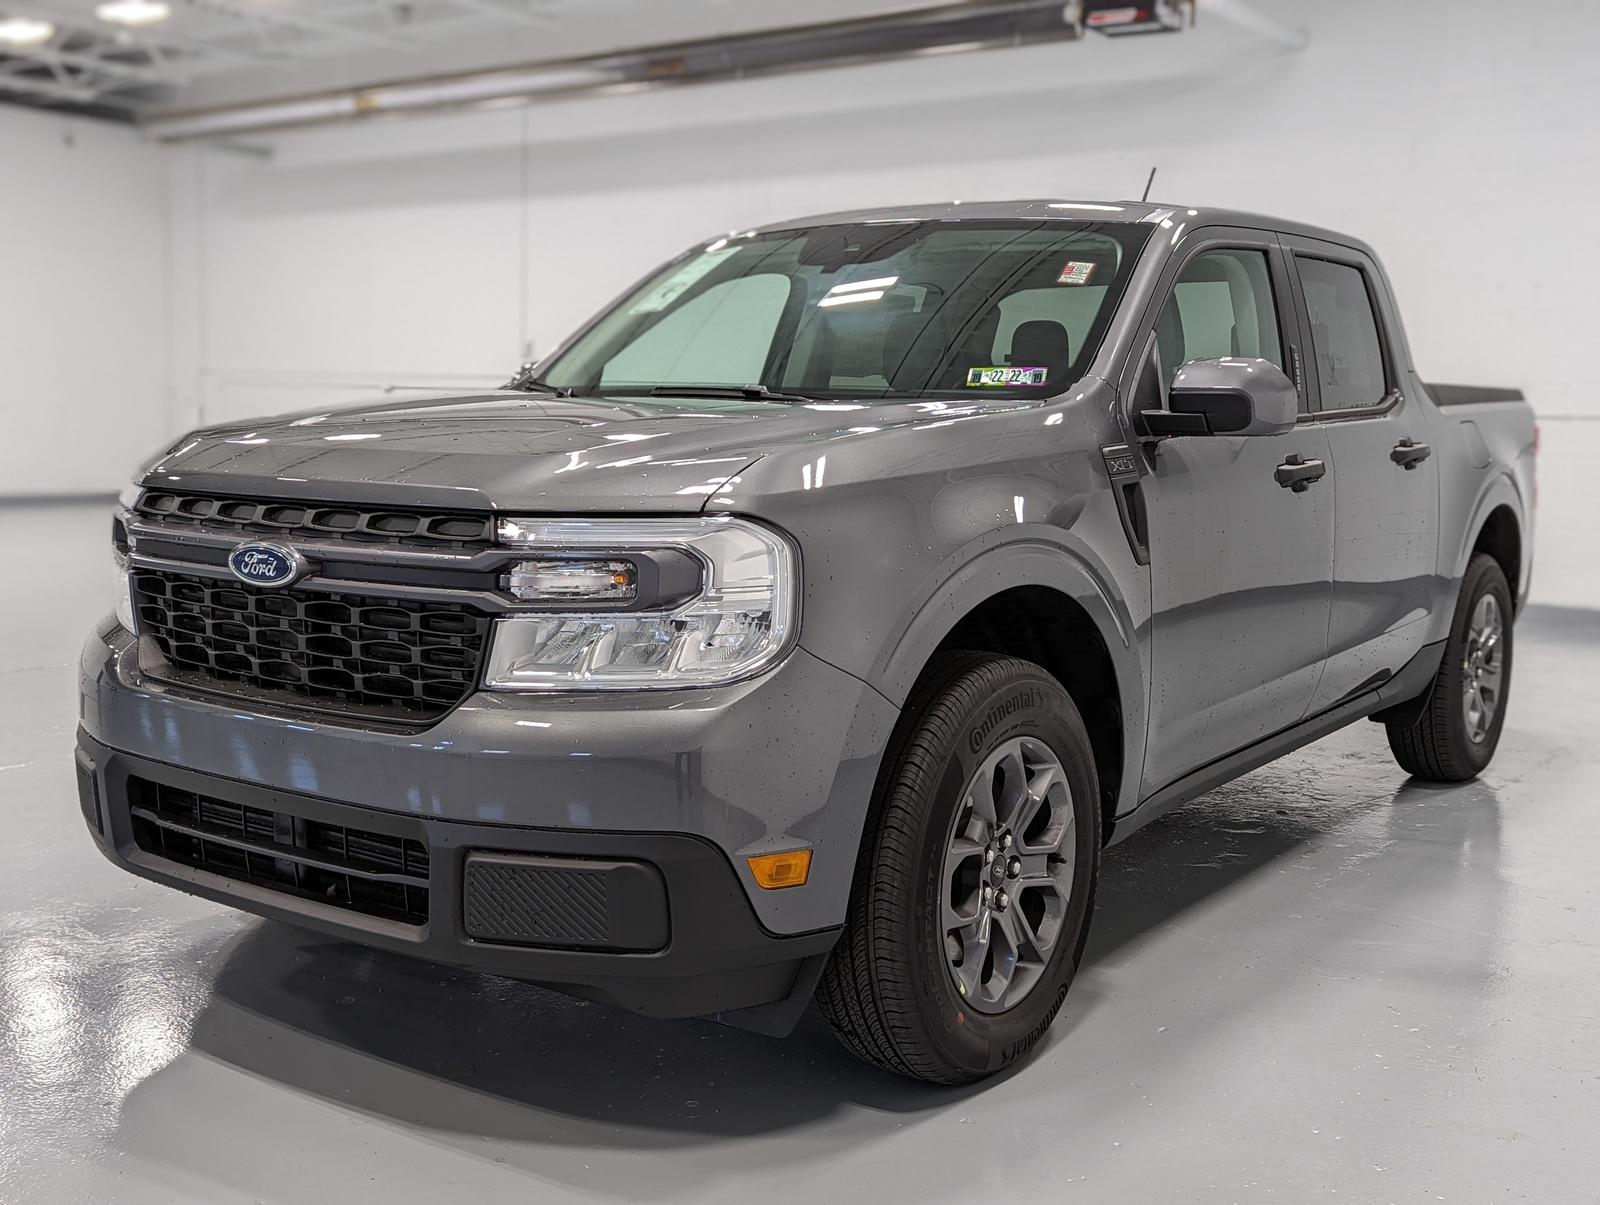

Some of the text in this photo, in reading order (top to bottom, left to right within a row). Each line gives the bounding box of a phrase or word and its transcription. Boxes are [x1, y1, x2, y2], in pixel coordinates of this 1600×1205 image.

[992, 370, 1004, 382] 22
[1010, 369, 1022, 382] 22
[241, 551, 277, 577] Ford
[968, 687, 1036, 754] Continental
